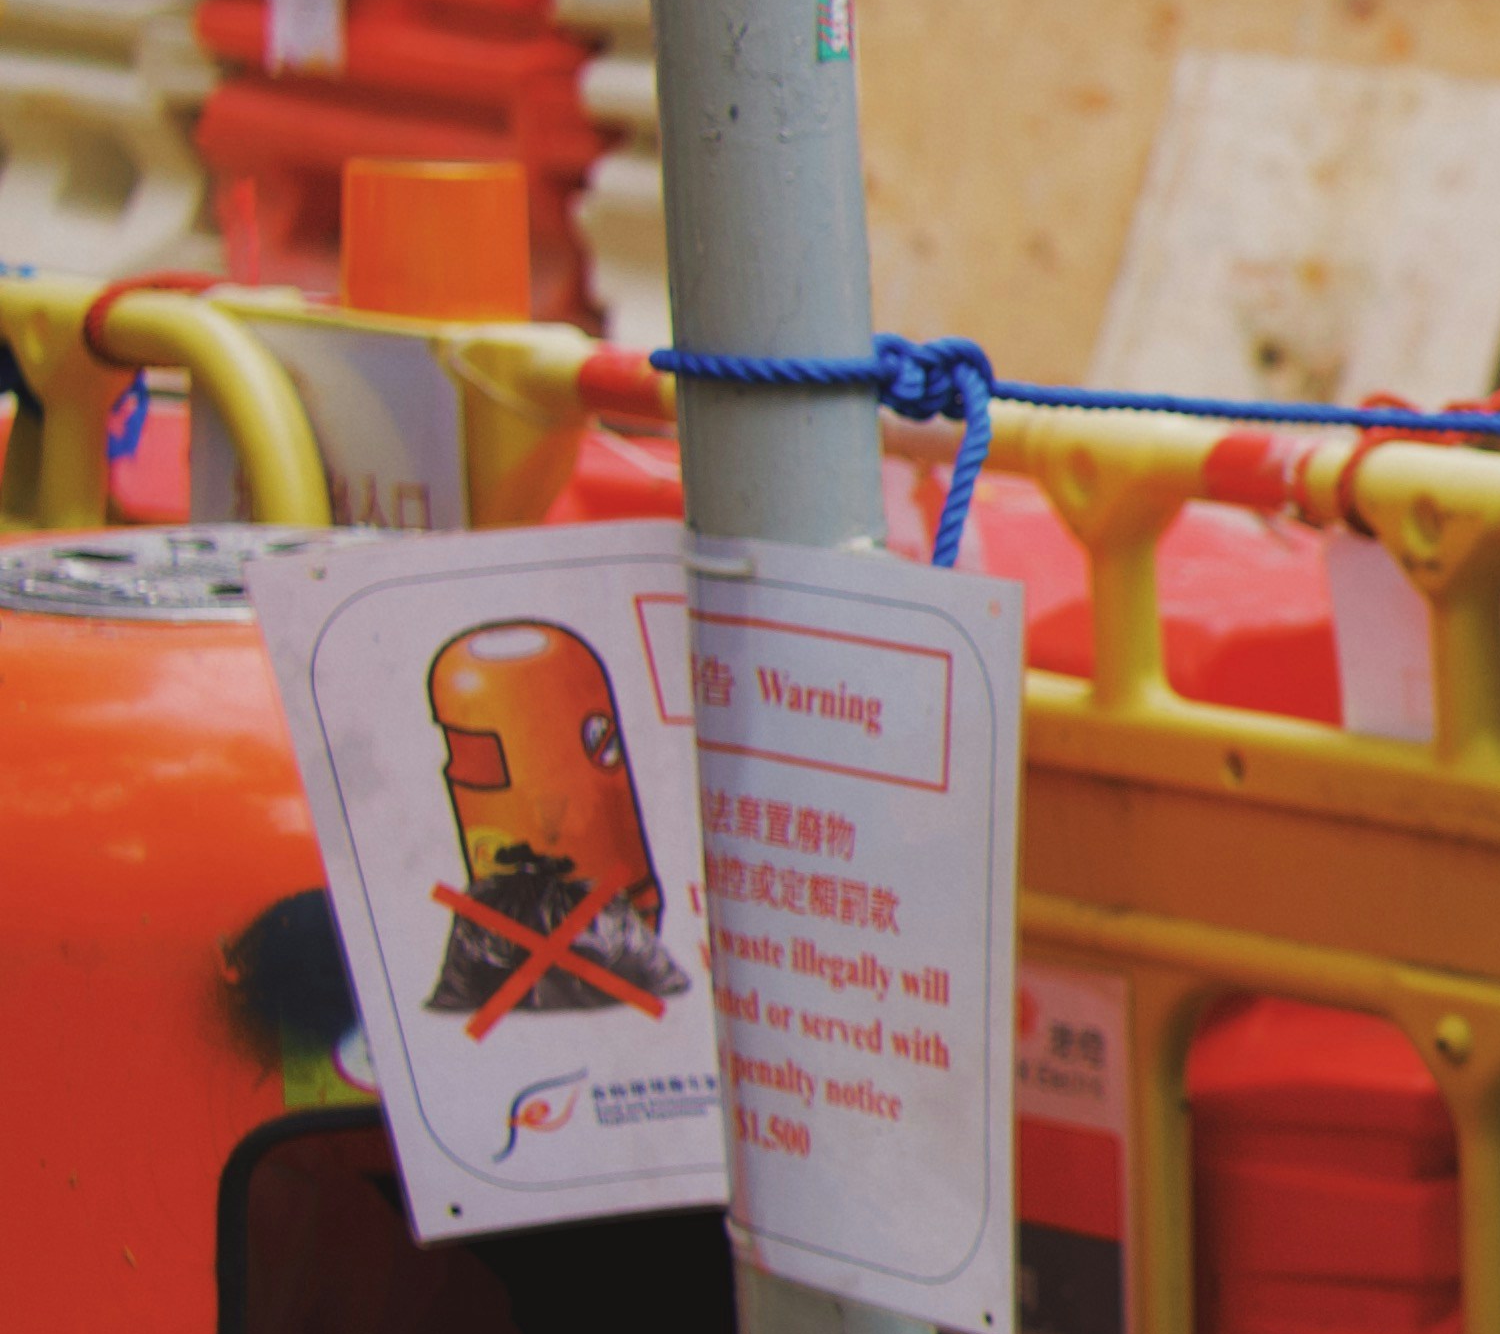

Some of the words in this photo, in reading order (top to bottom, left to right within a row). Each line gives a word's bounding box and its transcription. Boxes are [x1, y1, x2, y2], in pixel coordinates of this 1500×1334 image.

[756, 665, 882, 737] Warning
[791, 936, 891, 1002] illegally
[900, 966, 949, 1007] will
[765, 1002, 794, 1031] or
[800, 1010, 883, 1056] served
[890, 1026, 950, 1070] with
[824, 1078, 902, 1122] notice
